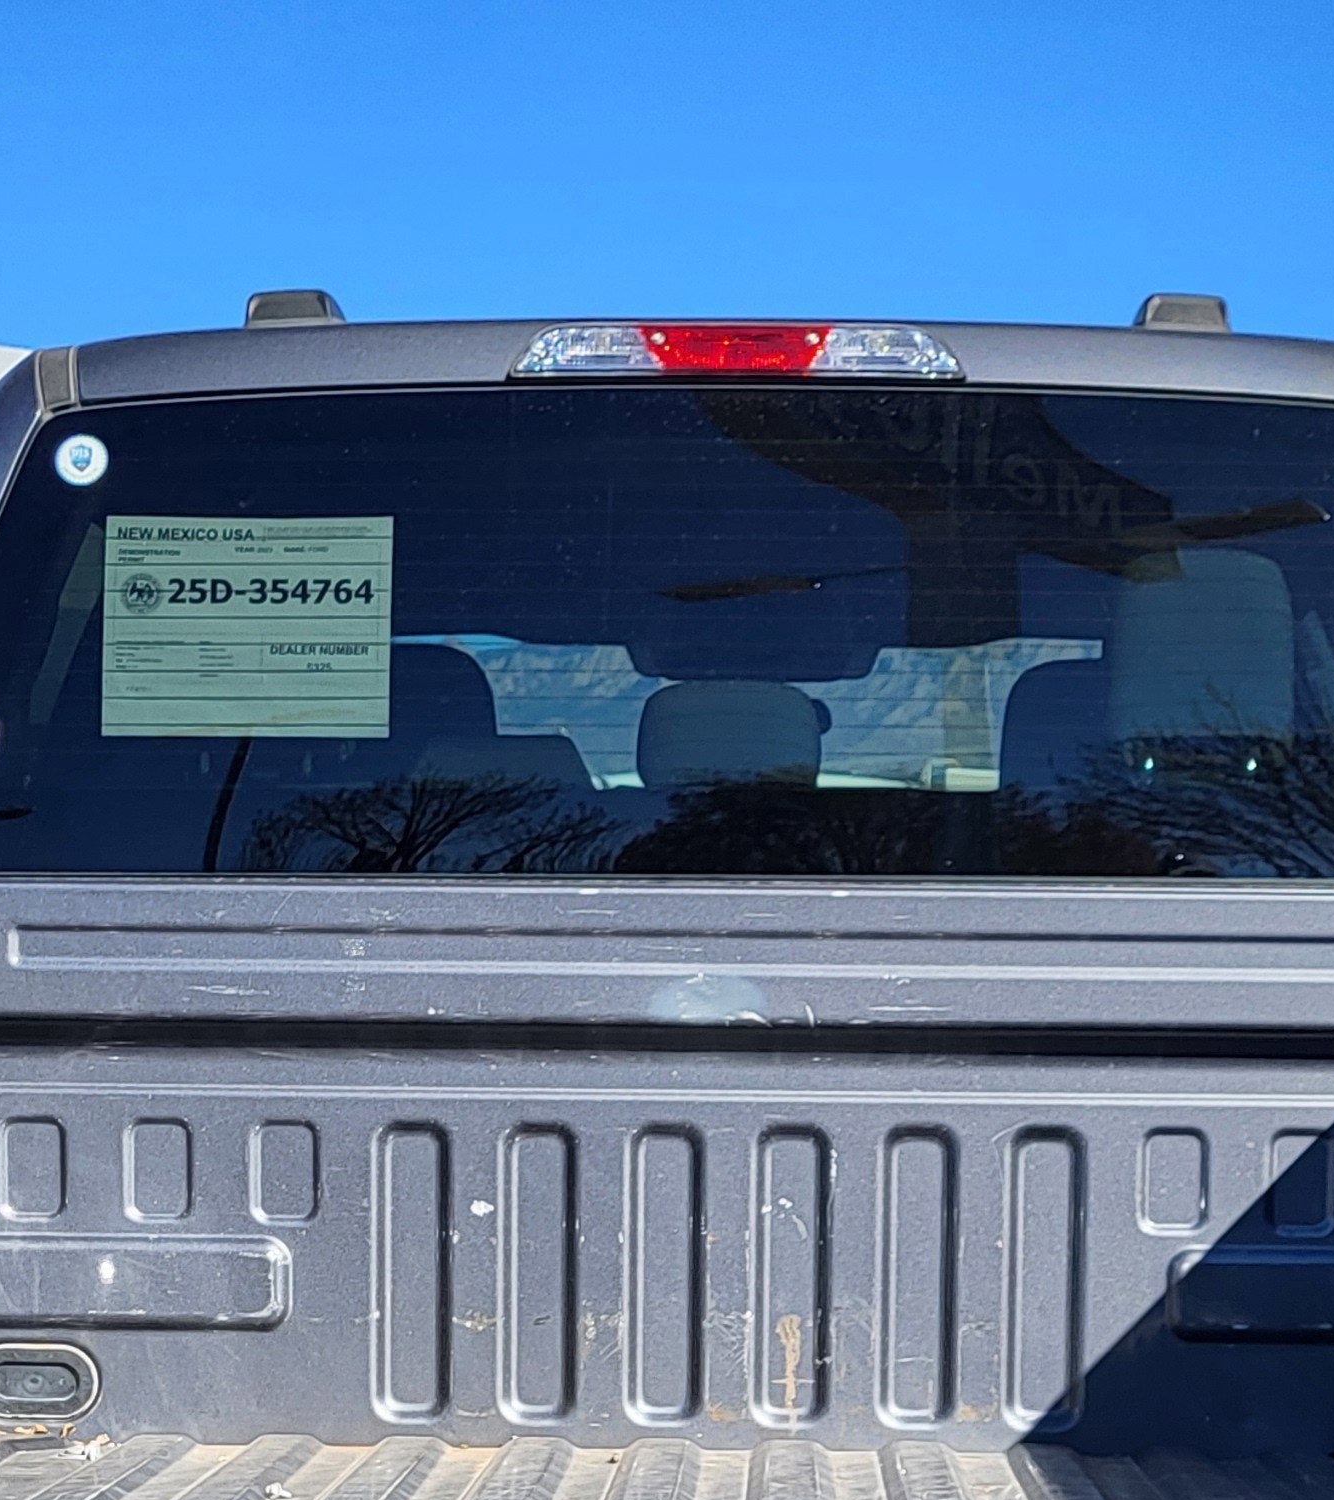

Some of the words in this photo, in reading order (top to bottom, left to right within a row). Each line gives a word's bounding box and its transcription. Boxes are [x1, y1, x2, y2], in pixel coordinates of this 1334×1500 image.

[117, 527, 153, 540] NEW
[157, 528, 218, 541] MEXICO
[222, 529, 255, 541] USA
[167, 578, 375, 605] 25D-354764
[270, 644, 316, 655] DEALER
[319, 644, 369, 656] NUMBER
